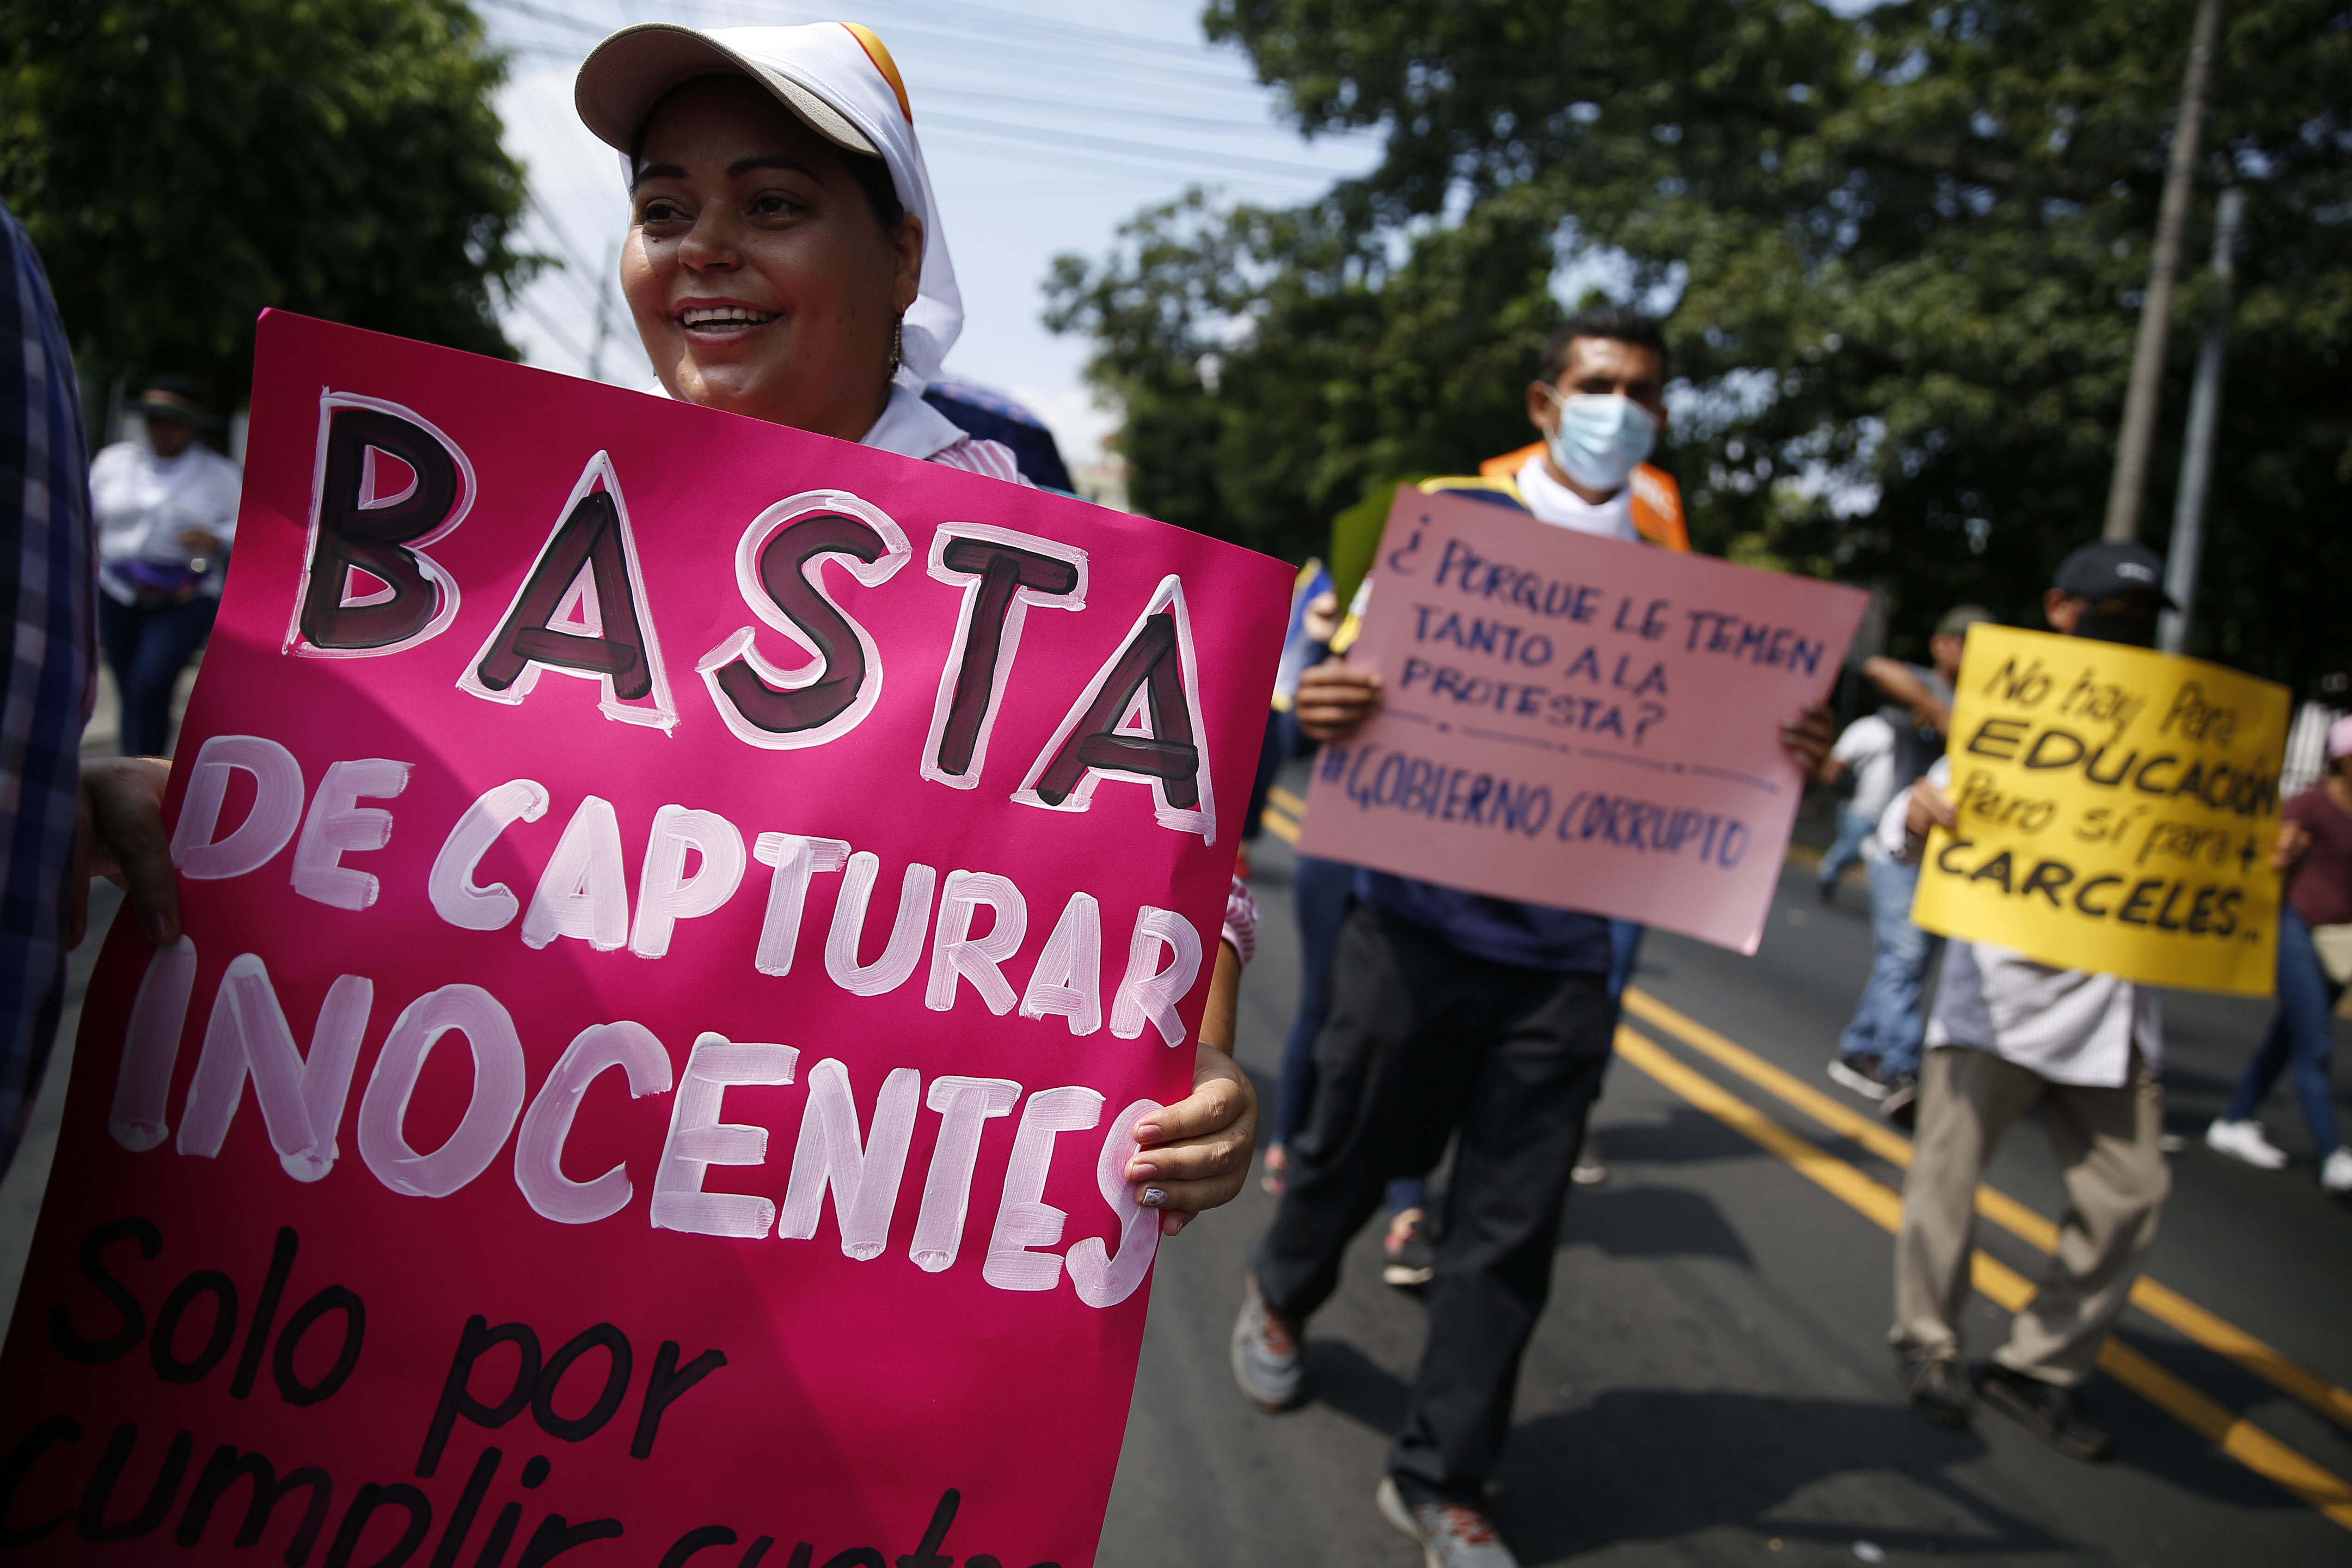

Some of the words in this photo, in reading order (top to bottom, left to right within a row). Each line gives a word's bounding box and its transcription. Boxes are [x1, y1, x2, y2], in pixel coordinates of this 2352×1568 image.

[281, 385, 1217, 847] BASTA
[1413, 603, 1553, 670] TANTO
[1564, 647, 1601, 690] A
[1613, 653, 1670, 697] LA
[1613, 597, 1672, 641] LE
[1685, 609, 1825, 676] TEMEN
[1398, 658, 1667, 748] PROTESTA?
[1982, 654, 2054, 708] No
[2057, 666, 2148, 747] hay
[1558, 791, 1750, 869] CORRUPTO
[1961, 769, 2057, 835] Pero
[170, 734, 415, 911] DE
[428, 777, 1204, 1049] CAPTURAR
[107, 932, 1166, 1309] INOCENTES
[48, 1216, 366, 1406] Solo
[414, 1314, 728, 1479] por
